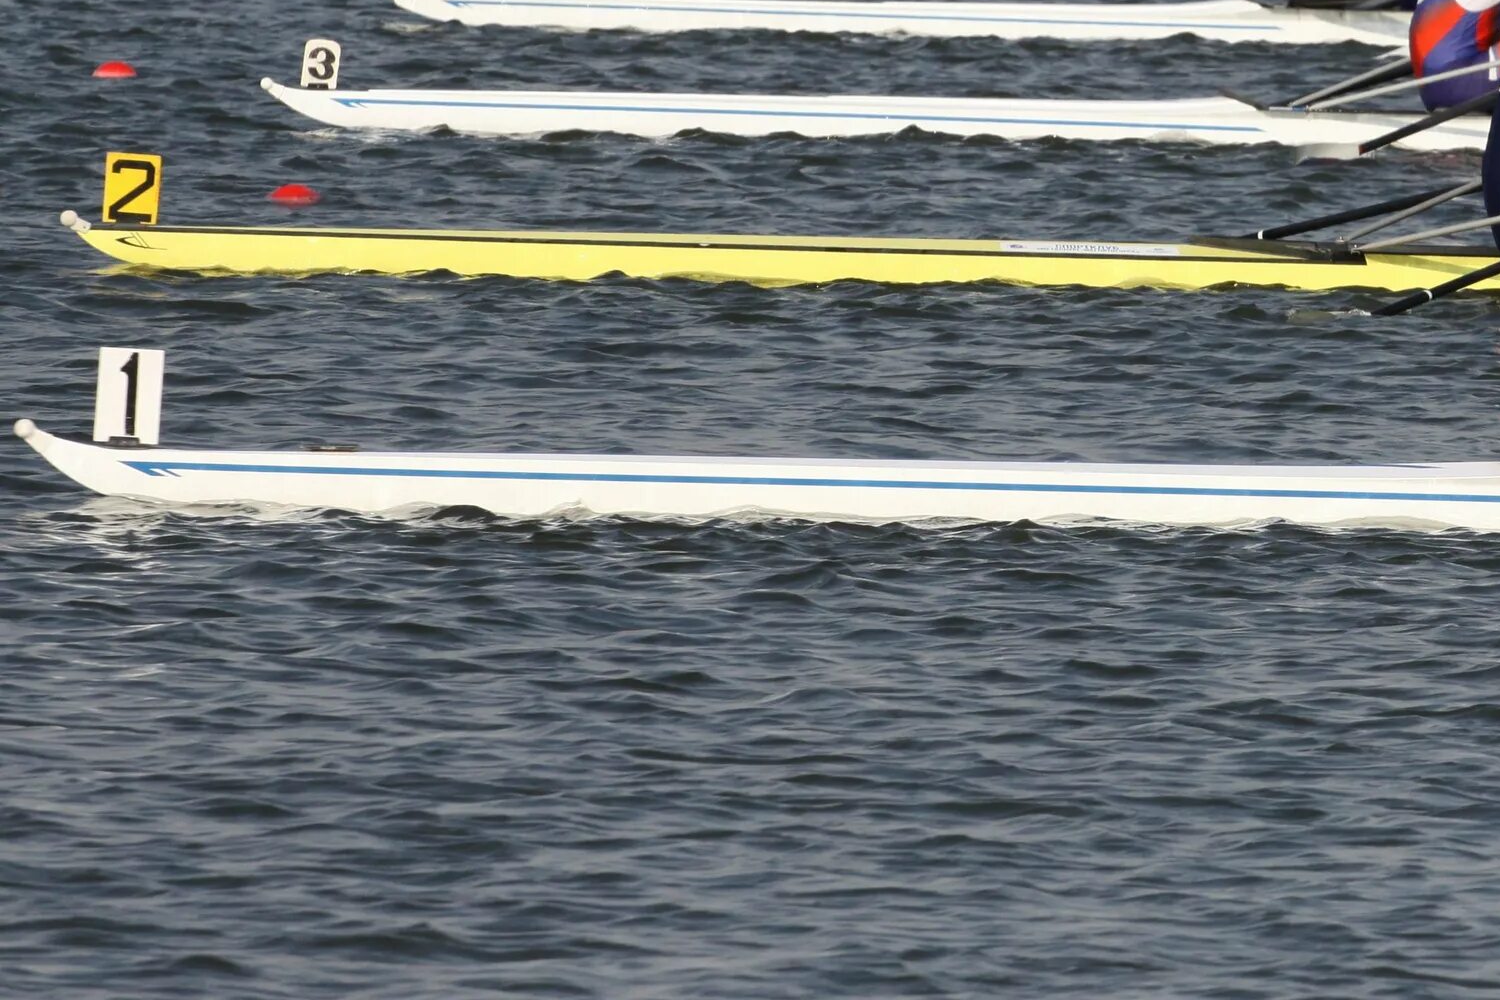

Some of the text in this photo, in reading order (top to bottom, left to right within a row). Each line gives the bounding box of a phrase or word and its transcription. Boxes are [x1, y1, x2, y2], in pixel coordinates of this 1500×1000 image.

[308, 47, 336, 80] 3
[109, 159, 155, 222] 2
[120, 352, 139, 436] 1
